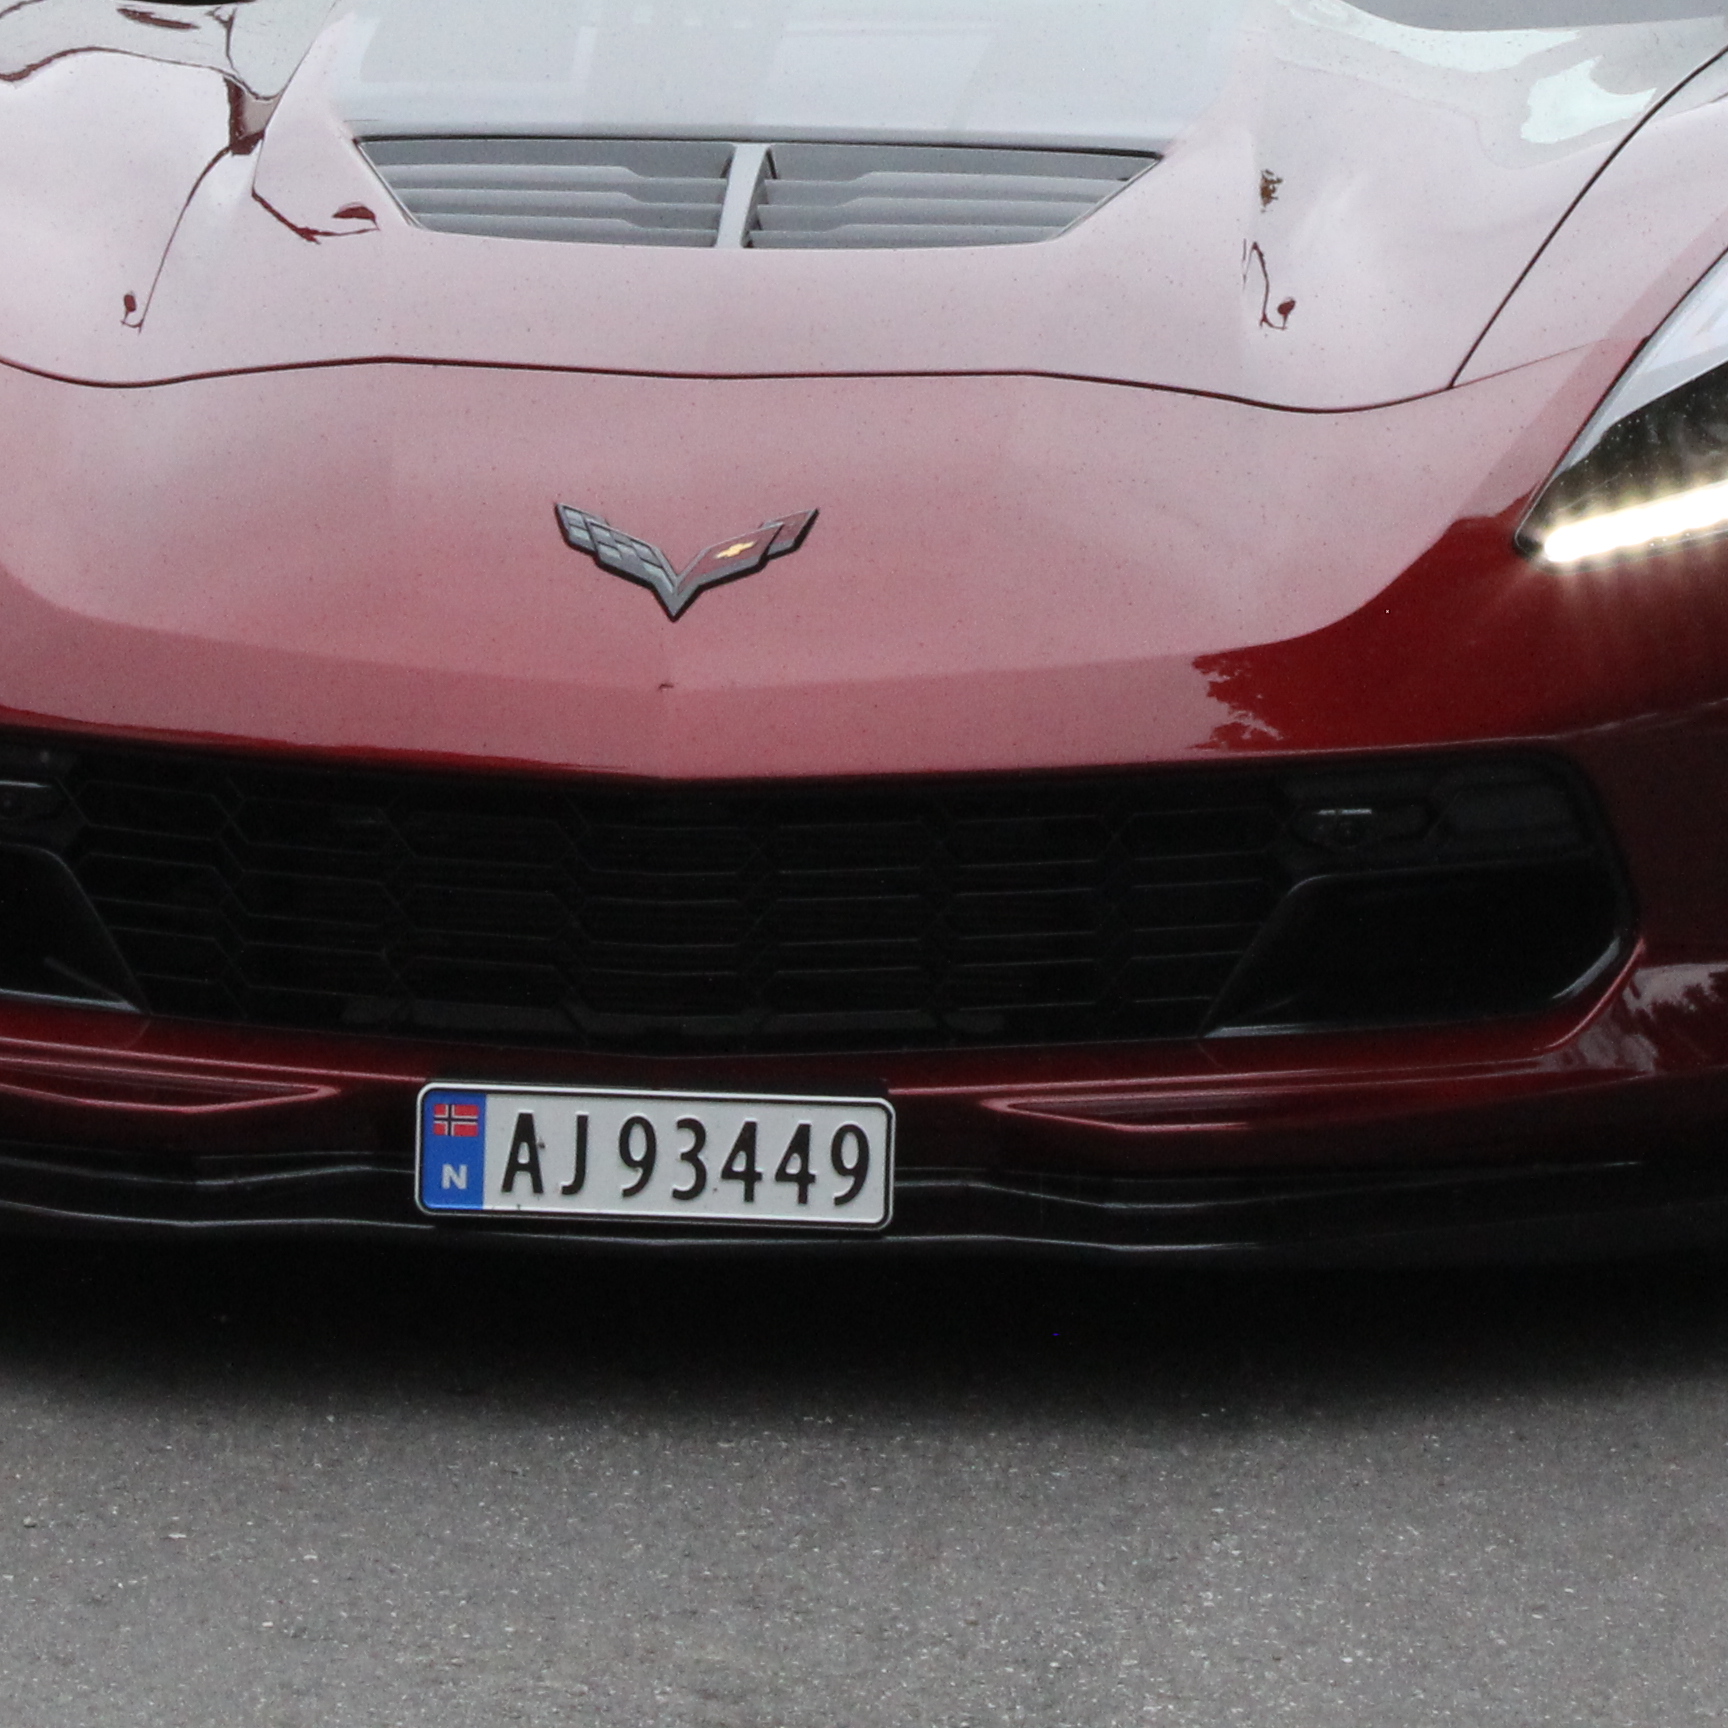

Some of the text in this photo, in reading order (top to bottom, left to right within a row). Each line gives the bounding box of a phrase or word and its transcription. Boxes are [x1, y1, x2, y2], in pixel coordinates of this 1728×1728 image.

[440, 1163, 469, 1190] N
[500, 1111, 871, 1207] AJ 93449
